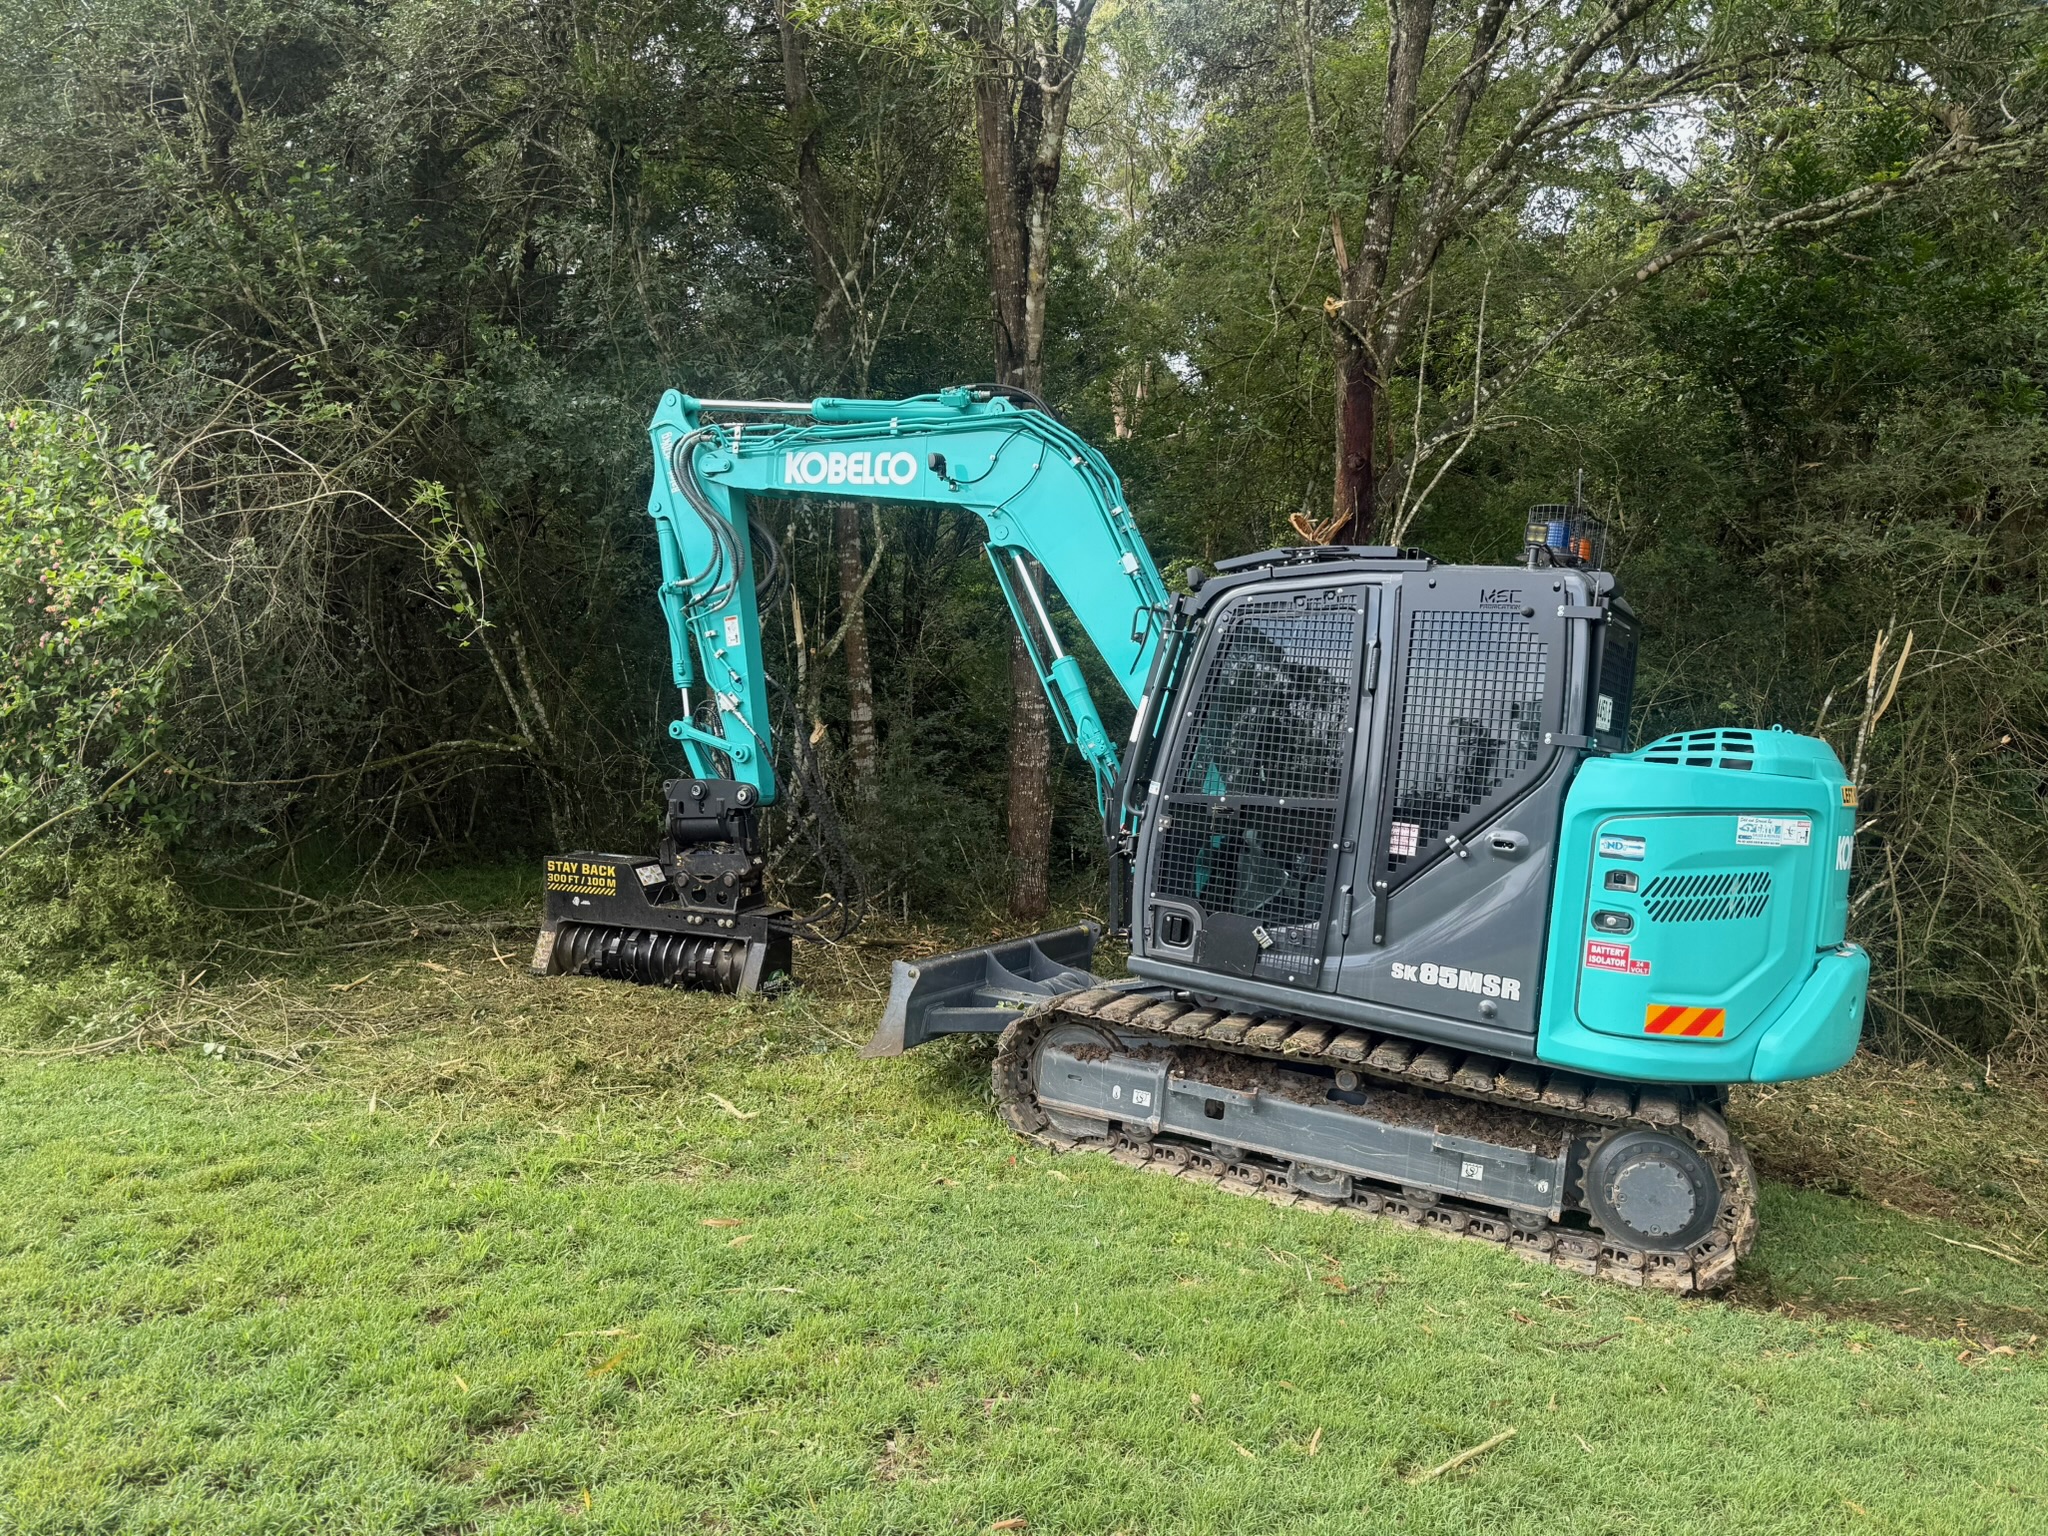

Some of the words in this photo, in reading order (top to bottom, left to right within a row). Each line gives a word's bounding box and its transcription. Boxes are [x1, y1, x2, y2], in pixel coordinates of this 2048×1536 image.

[784, 451, 917, 485] KOBELCO
[1480, 589, 1522, 603] MSC
[547, 860, 578, 874] STAY
[581, 863, 616, 877] BACK
[547, 873, 567, 882] 300
[568, 875, 579, 884] FT
[580, 876, 585, 884] /
[587, 877, 606, 887] 100
[606, 879, 616, 887] M
[1591, 945, 1626, 957] BATTERY
[1588, 954, 1626, 967] ISOLATOR
